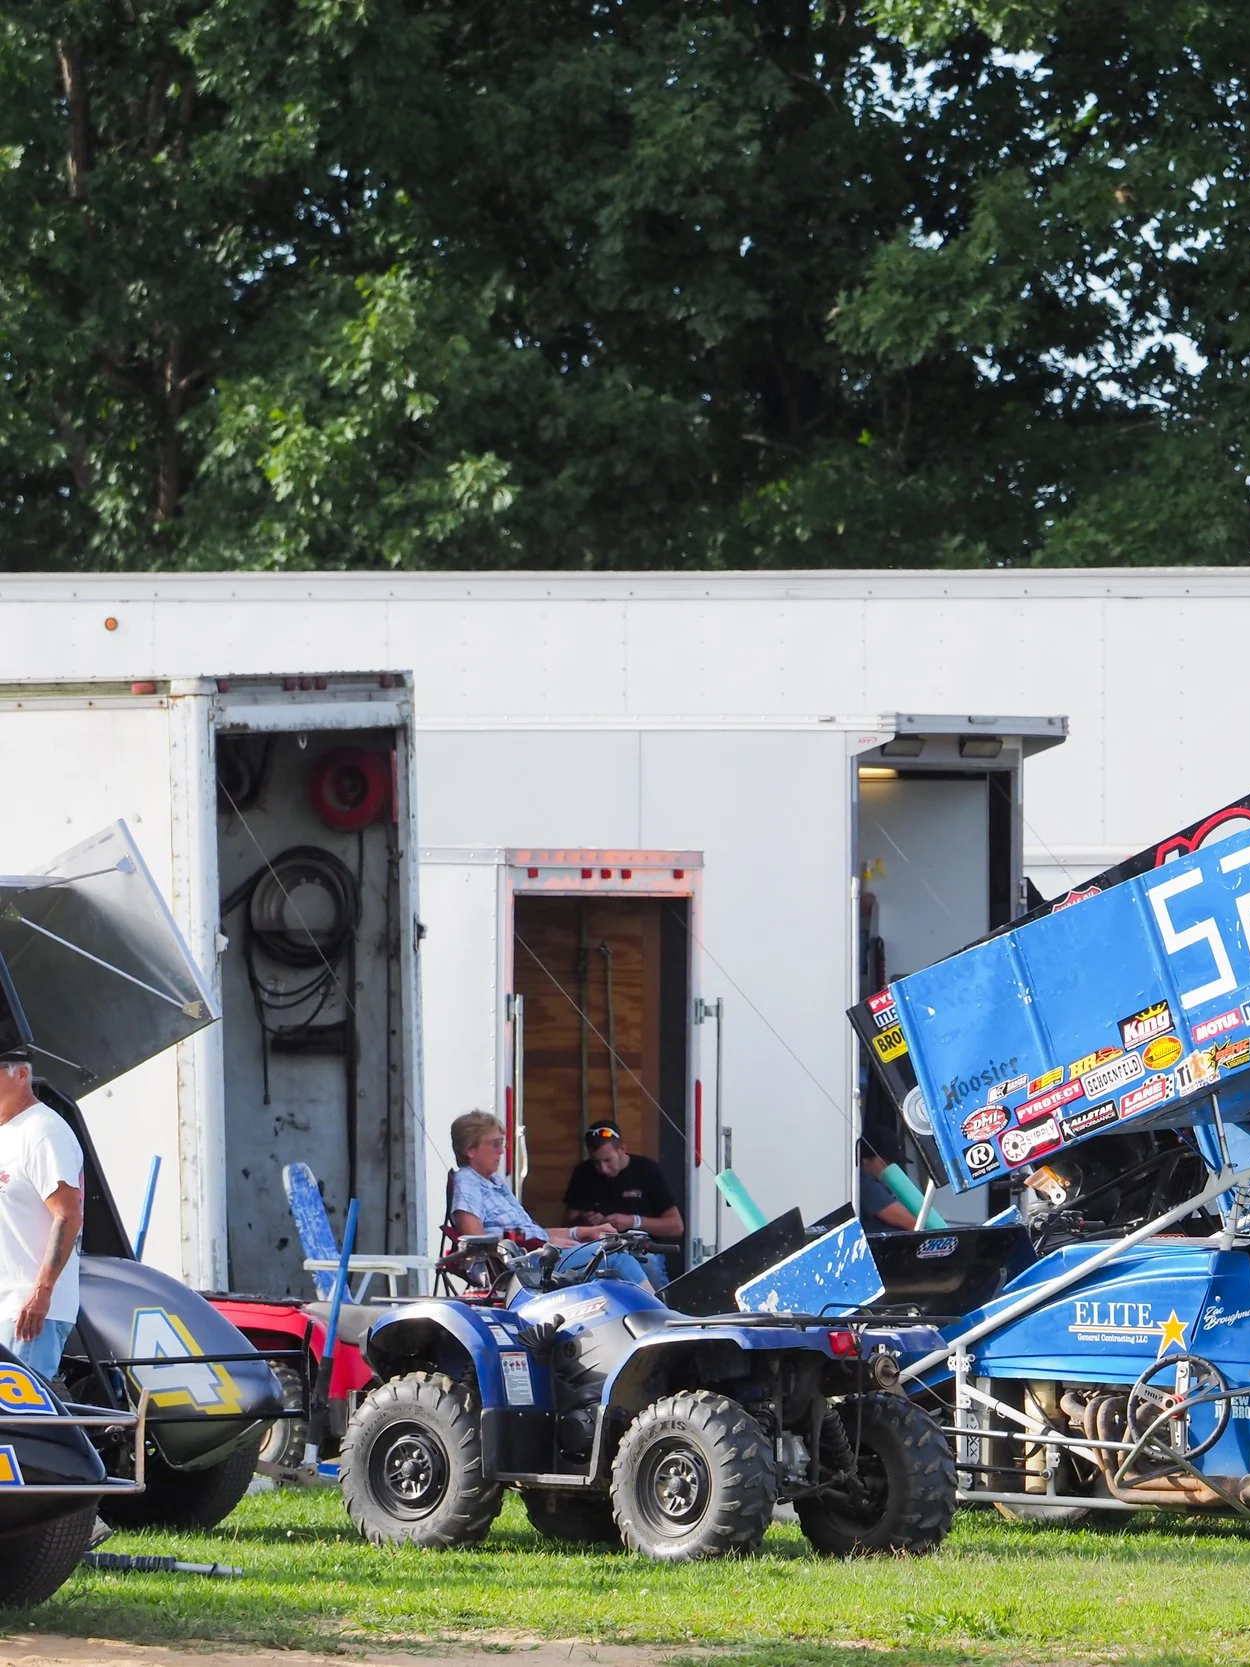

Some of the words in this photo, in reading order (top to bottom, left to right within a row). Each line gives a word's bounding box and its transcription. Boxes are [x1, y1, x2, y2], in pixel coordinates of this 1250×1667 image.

[1124, 1008, 1171, 1043] King
[1196, 1013, 1240, 1041] MOTUL
[941, 1057, 1019, 1111] Hoosier
[1087, 1057, 1140, 1093] SCHOENFELD
[1018, 1083, 1081, 1121] PYROTECT
[1125, 1082, 1164, 1108] LANE
[1070, 1104, 1114, 1127] ALLSTAR
[1026, 1123, 1056, 1145] SUPPLY
[1075, 1301, 1154, 1328] ELITE
[1204, 1306, 1224, 1321] Zac
[1077, 1333, 1100, 1342] General
[1101, 1333, 1135, 1344] Contracting
[1136, 1335, 1148, 1343] LLC
[128, 1307, 241, 1414] 4
